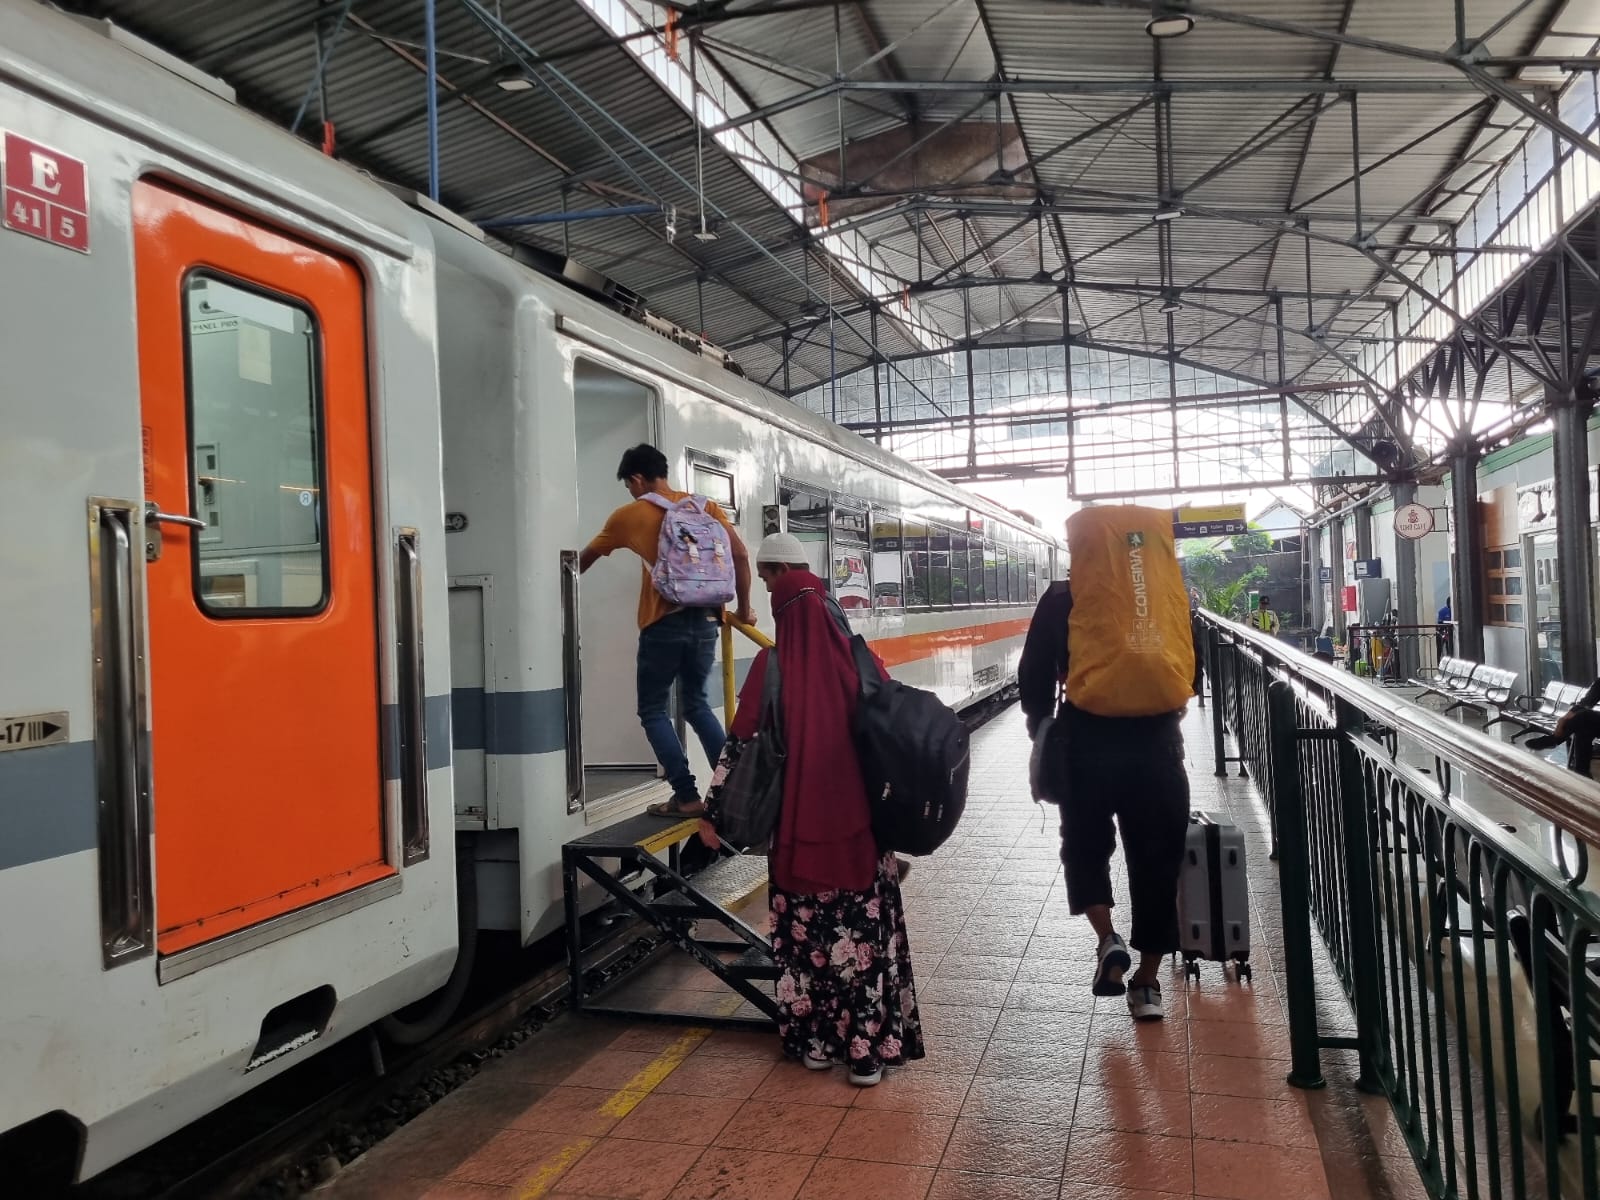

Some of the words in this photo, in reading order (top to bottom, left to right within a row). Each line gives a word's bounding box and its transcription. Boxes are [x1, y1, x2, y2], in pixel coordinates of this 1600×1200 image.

[29, 151, 62, 196] E
[12, 200, 42, 230] 41
[59, 215, 76, 239] 5
[1129, 548, 1148, 617] CONSINA
